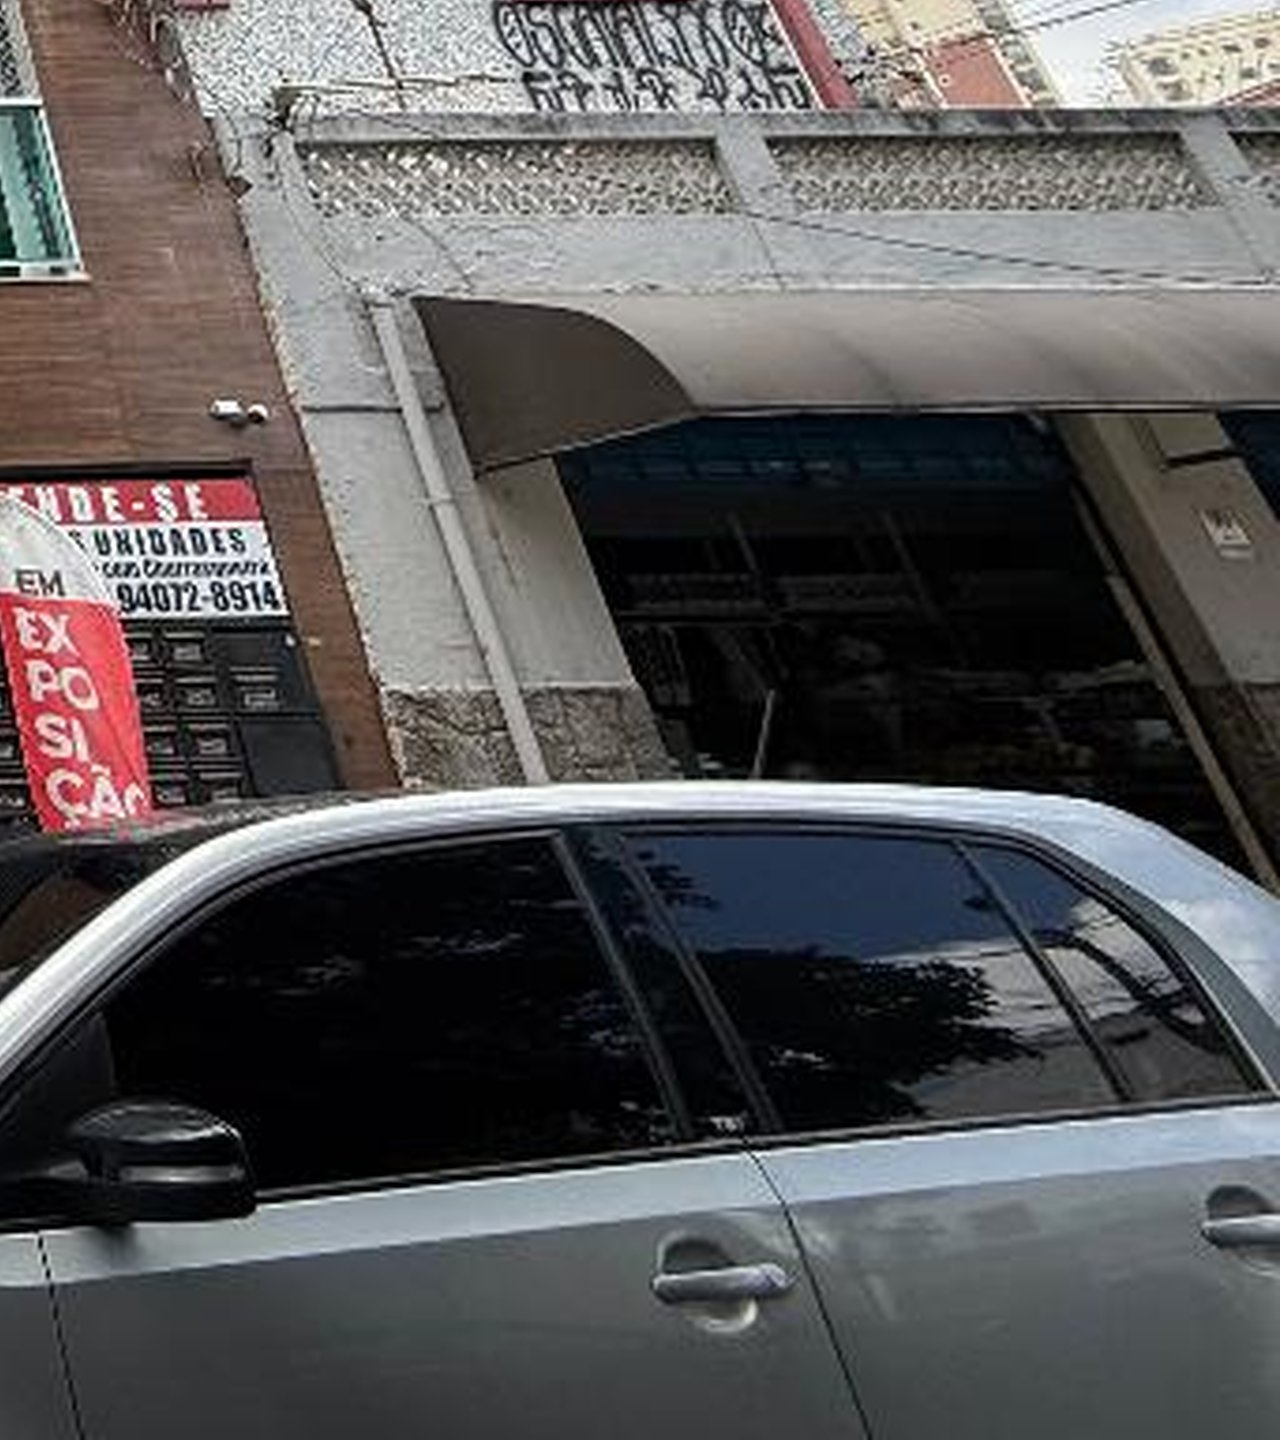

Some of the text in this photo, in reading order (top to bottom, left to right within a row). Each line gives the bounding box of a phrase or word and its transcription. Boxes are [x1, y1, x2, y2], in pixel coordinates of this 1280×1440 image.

[5, 482, 209, 523] NDE-SE
[94, 527, 246, 556] UNIDADES
[16, 569, 66, 597] EM
[13, 607, 80, 656] EX
[25, 659, 101, 711] PO
[34, 712, 90, 763] SI
